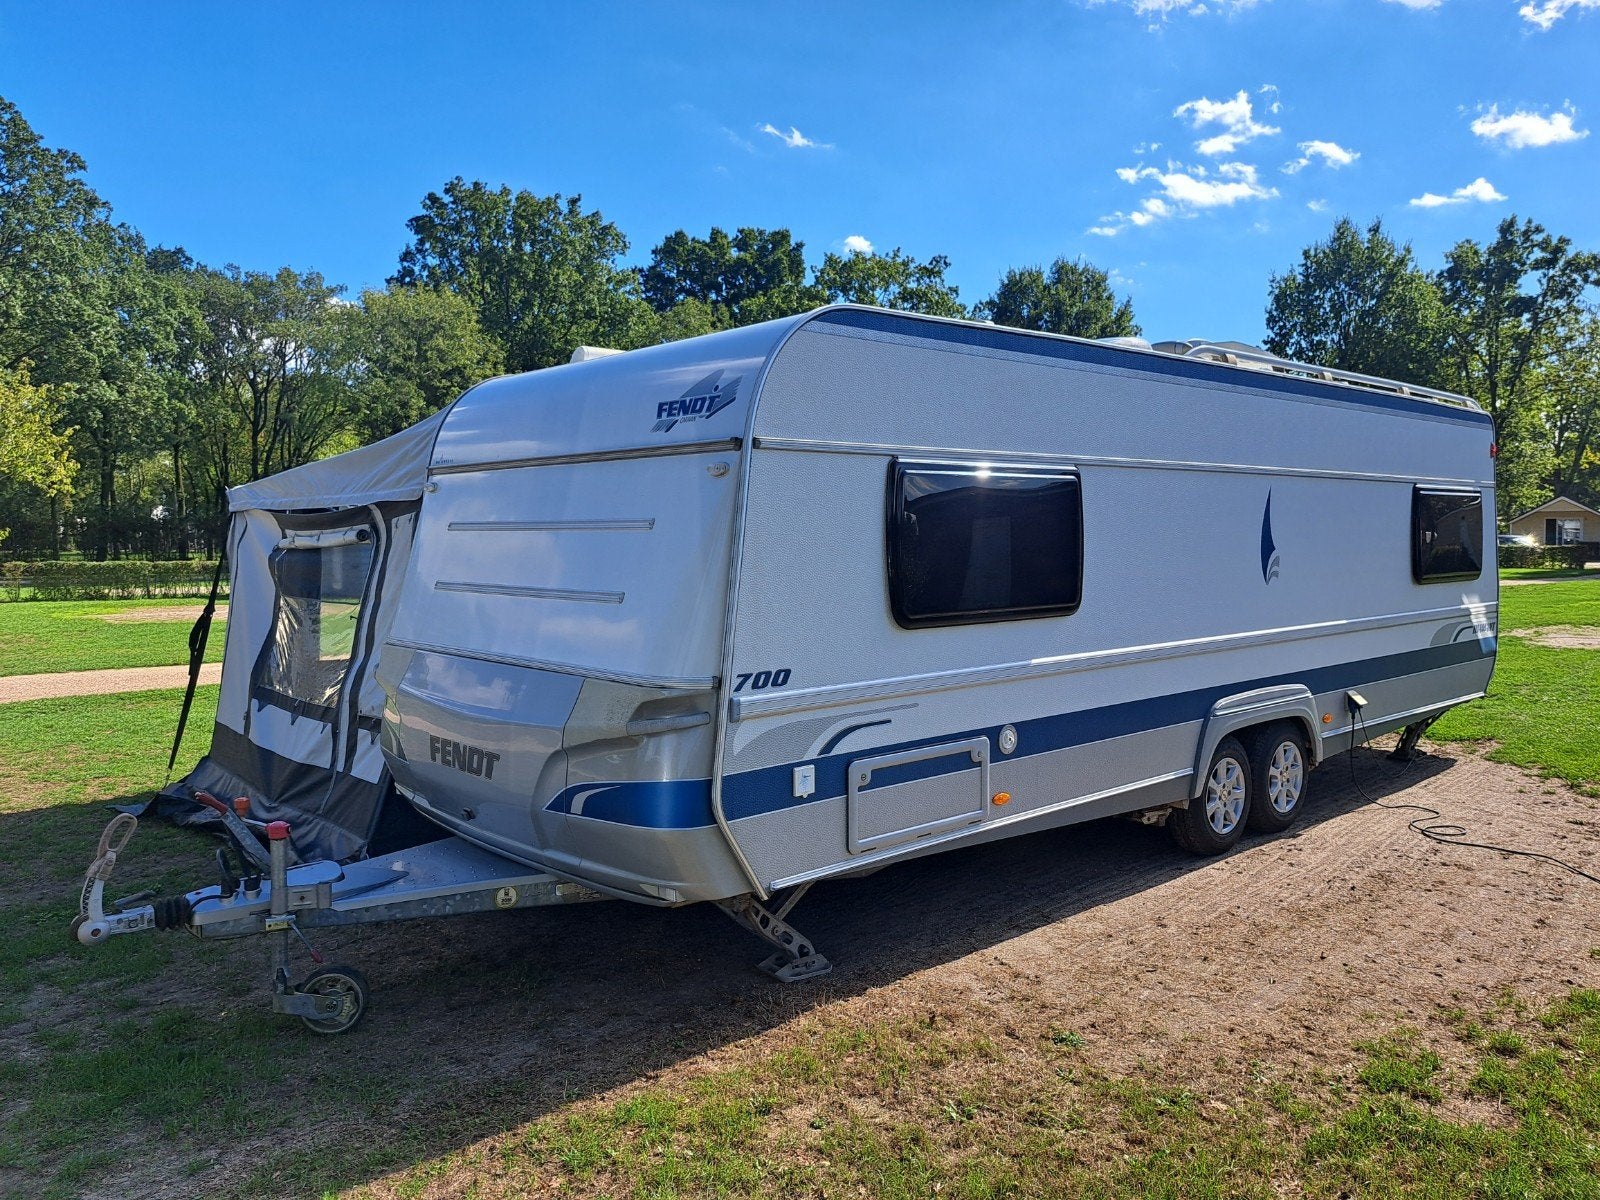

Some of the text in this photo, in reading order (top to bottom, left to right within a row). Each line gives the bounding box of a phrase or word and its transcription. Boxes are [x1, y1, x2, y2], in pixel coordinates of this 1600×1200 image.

[656, 394, 721, 419] FENDT
[733, 668, 792, 692] 700
[429, 734, 501, 780] FENDT
